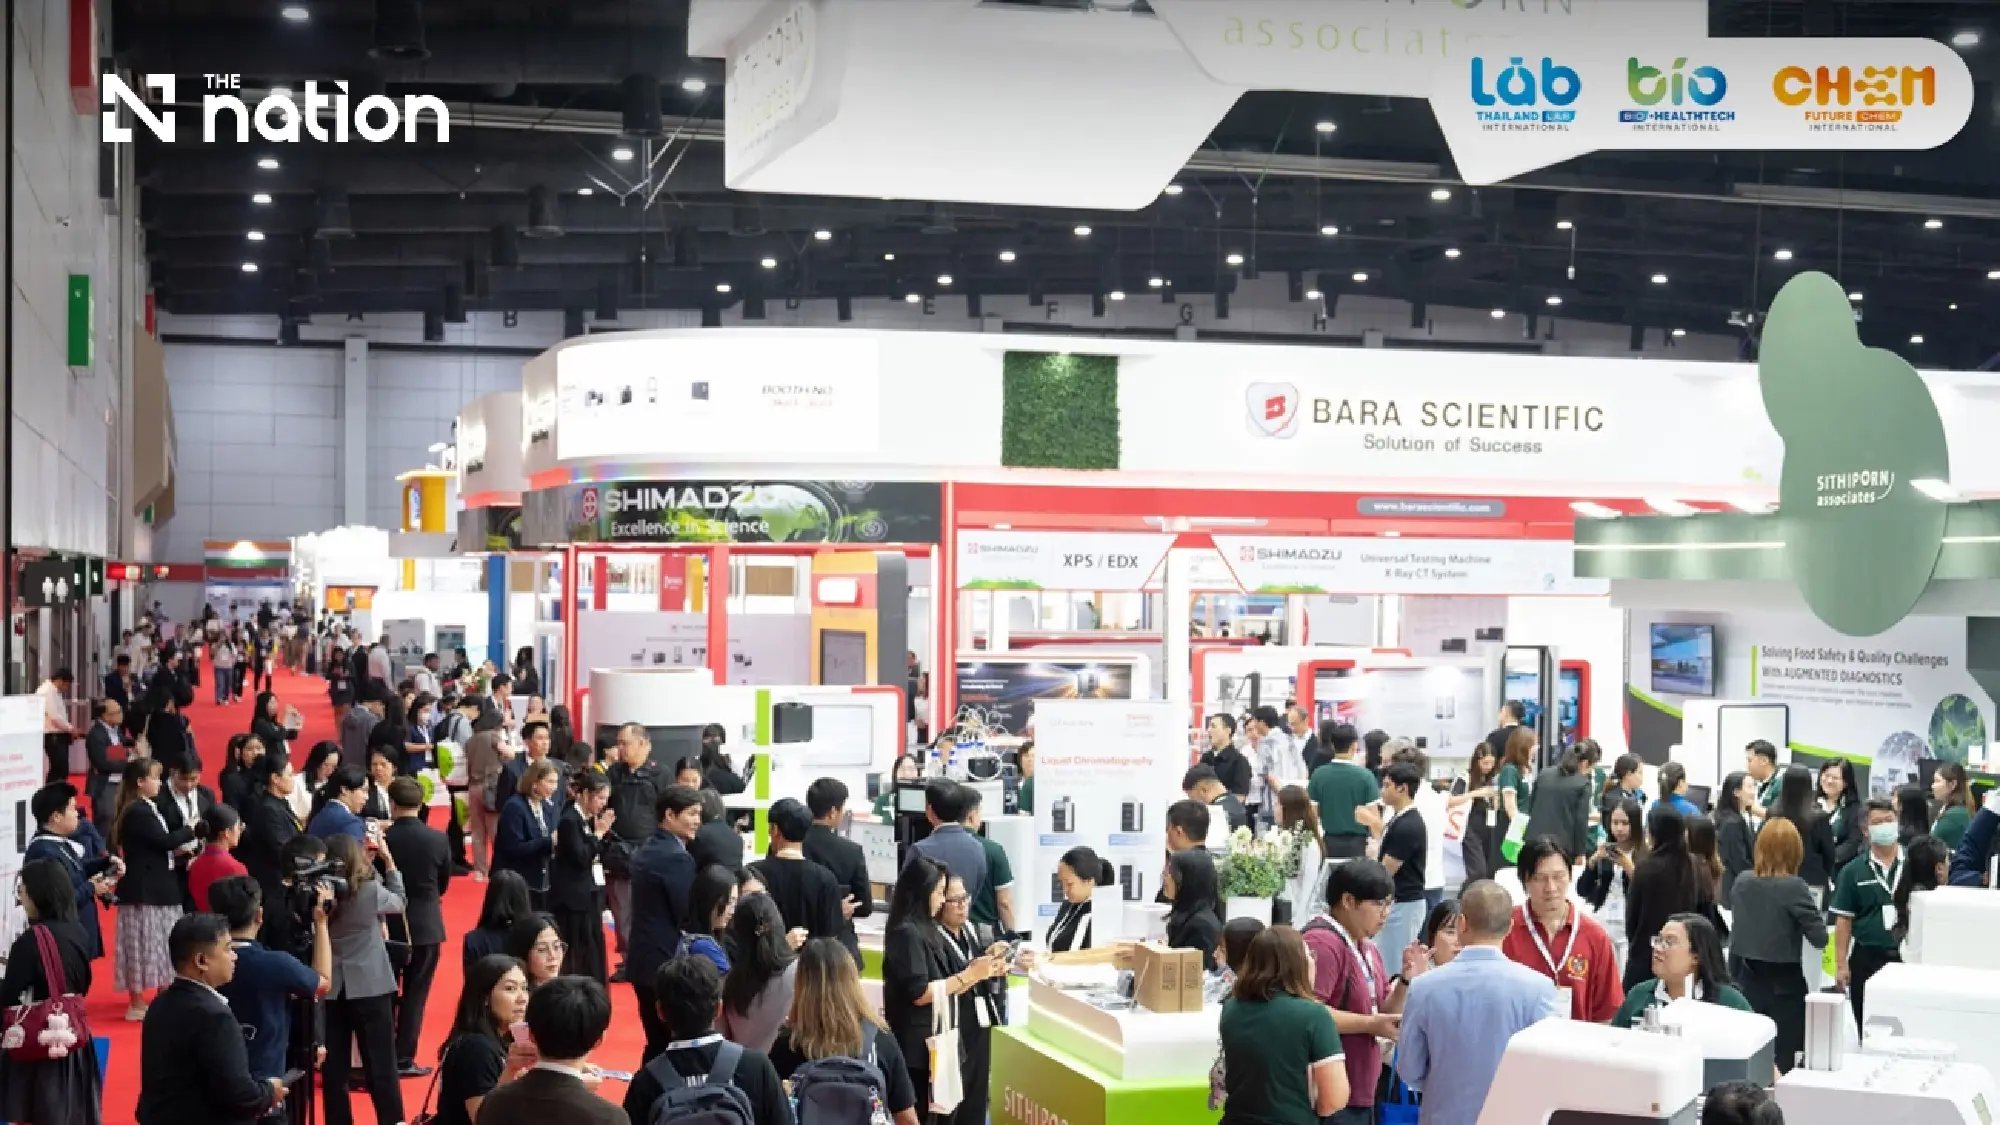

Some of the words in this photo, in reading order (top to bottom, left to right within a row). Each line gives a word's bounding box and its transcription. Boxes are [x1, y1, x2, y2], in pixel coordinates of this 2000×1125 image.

[1223, 16, 1514, 56] associat
[922, 299, 935, 315] E
[1046, 301, 1059, 320] F
[1180, 302, 1193, 324] G
[504, 310, 517, 328] B
[1312, 311, 1326, 332] H
[1313, 398, 1402, 427] BARA
[1420, 401, 1604, 431] SCIENTIFIC
[1364, 434, 1436, 452] Solution
[1444, 436, 1461, 452] of
[1470, 436, 1543, 454] Success
[1817, 469, 1889, 491] SITHIPORN
[604, 486, 772, 513] SHIMADZ
[1817, 490, 1876, 506] associates
[611, 519, 680, 537] Excellence
[707, 518, 770, 536] Science
[1063, 554, 1094, 569] XPS
[1107, 554, 1139, 570] EDX
[1256, 547, 1343, 562] SHIMADZU
[1360, 553, 1409, 565] Universal
[1411, 554, 1446, 567] Testing
[1449, 555, 1492, 565] Machine
[1416, 568, 1430, 579] CT
[1433, 569, 1468, 580] System
[1762, 646, 1792, 663] Solving
[1794, 647, 1816, 661] Food
[1818, 648, 1846, 664] Safety
[1857, 649, 1892, 667] Quality
[1893, 652, 1949, 669] Challenges
[1785, 667, 1838, 682] AUGMENTED
[1840, 669, 1904, 686] DIAGNOSTICS
[1074, 755, 1153, 766] Chromatography
